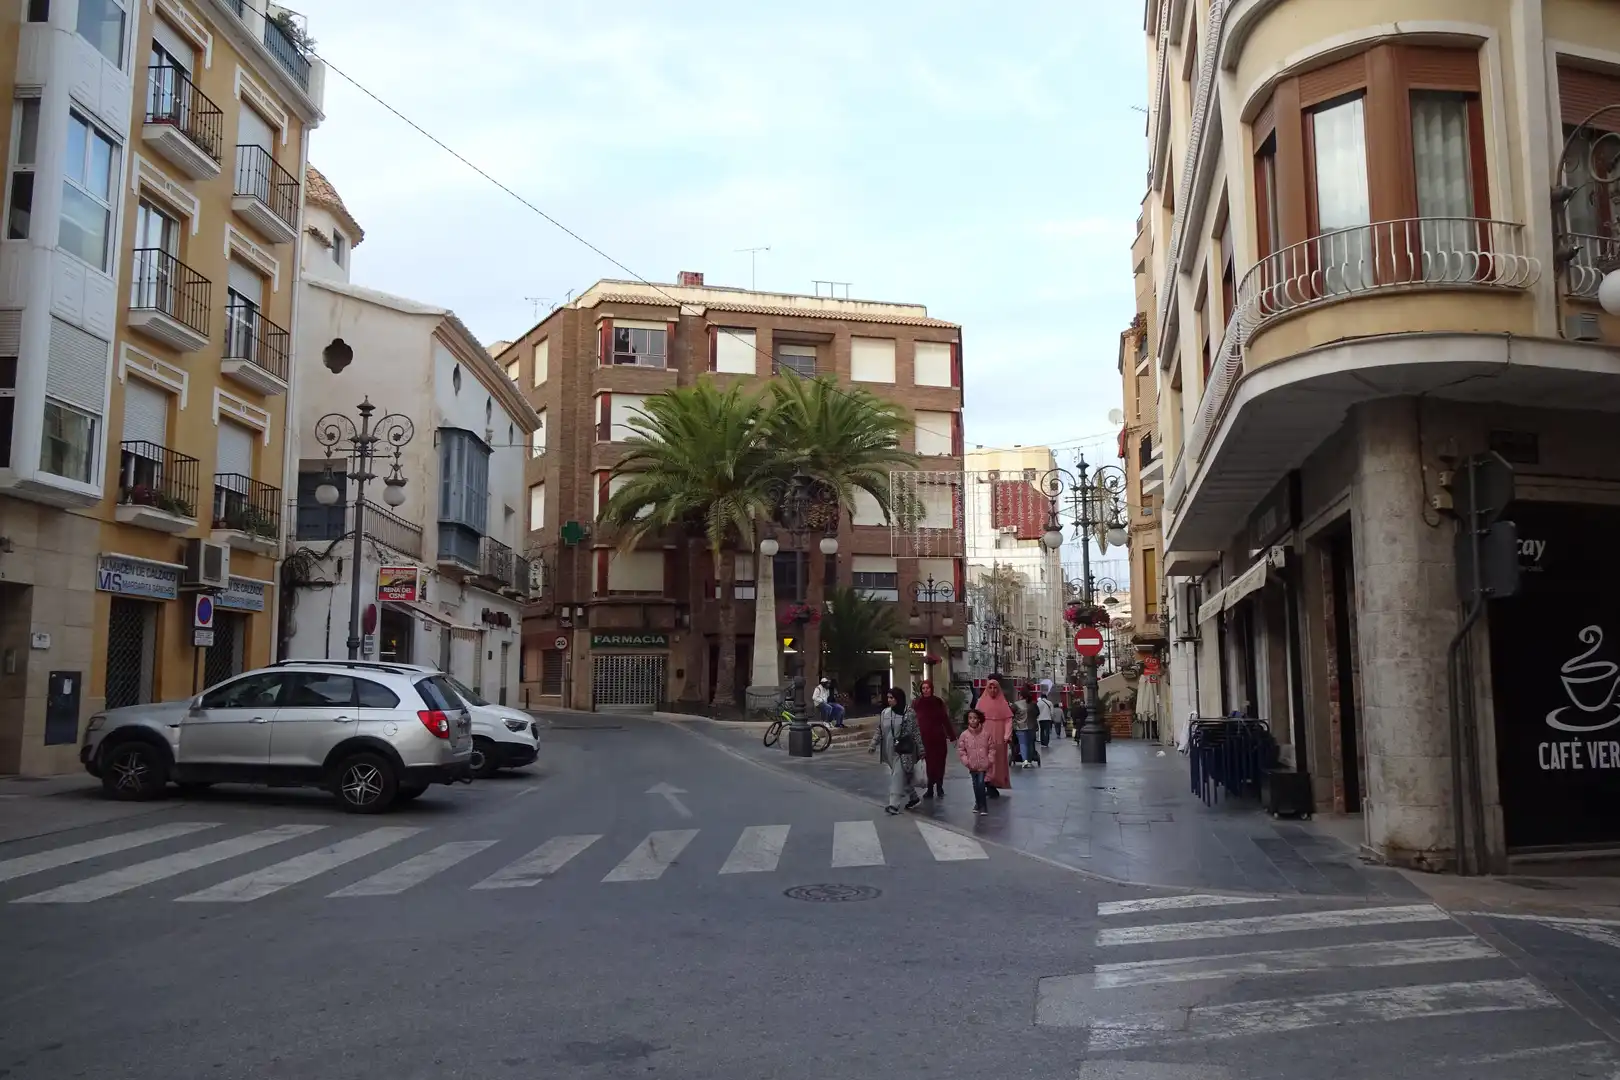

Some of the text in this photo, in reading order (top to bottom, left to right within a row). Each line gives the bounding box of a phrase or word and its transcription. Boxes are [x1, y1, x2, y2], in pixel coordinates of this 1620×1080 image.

[136, 565, 145, 577] DE
[146, 567, 177, 582] CALZADO
[122, 579, 152, 591] MARGARITA
[556, 639, 566, 647] 20
[593, 635, 665, 644] FARMACIA
[1538, 736, 1584, 770] CAFÉ
